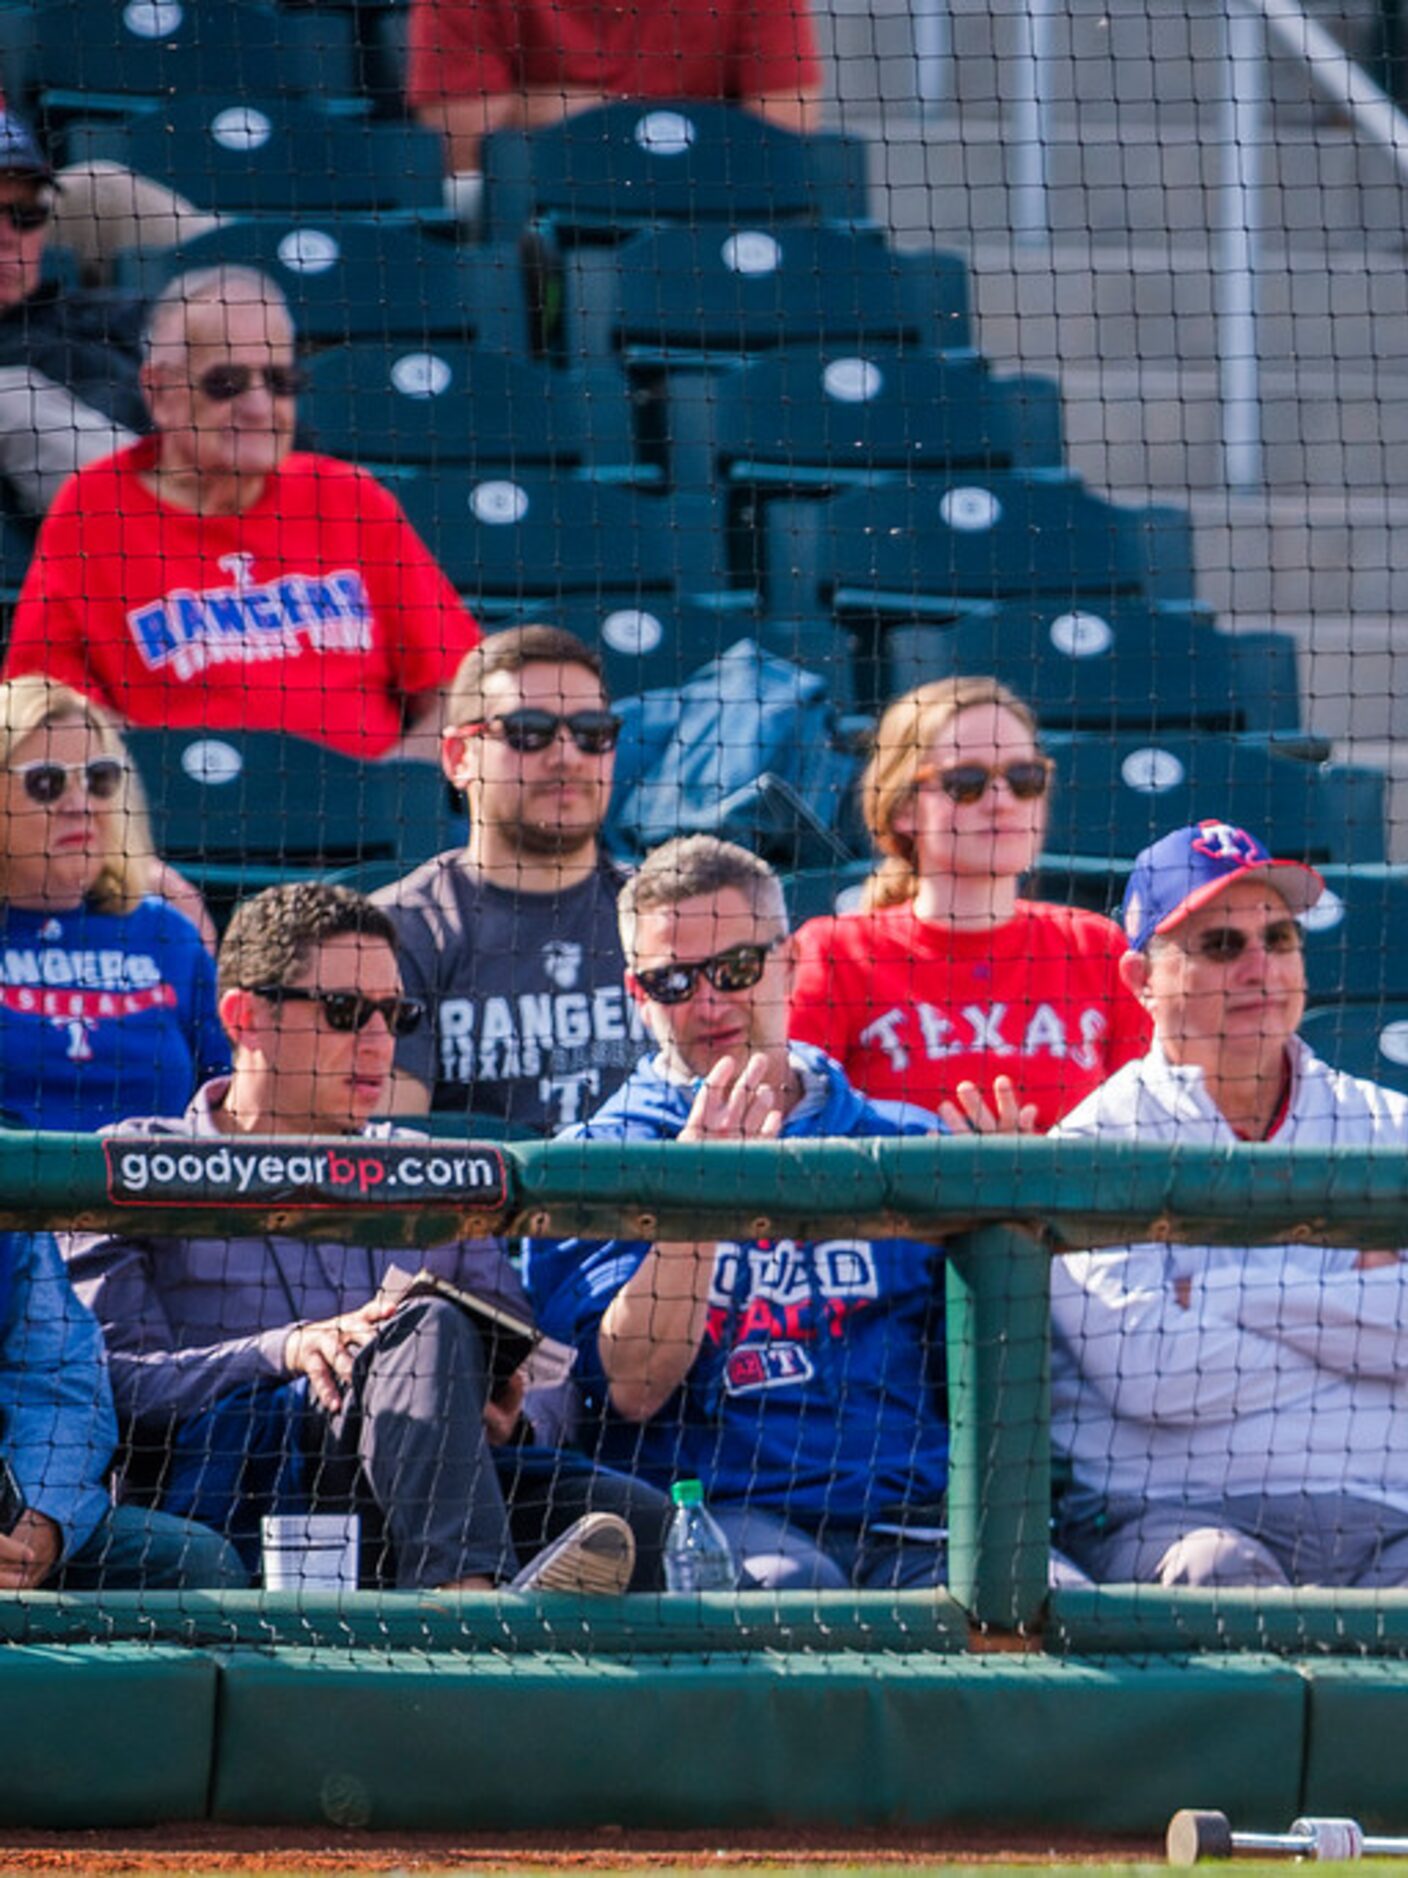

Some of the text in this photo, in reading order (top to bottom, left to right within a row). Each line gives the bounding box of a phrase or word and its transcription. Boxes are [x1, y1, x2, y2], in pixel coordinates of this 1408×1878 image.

[128, 570, 371, 667] RANGERS
[0, 949, 161, 985] NGERS
[51, 1016, 99, 1061] T
[860, 1002, 1106, 1072] TEXAS
[539, 1069, 600, 1133] T
[121, 1148, 493, 1192] goodyearbp.com
